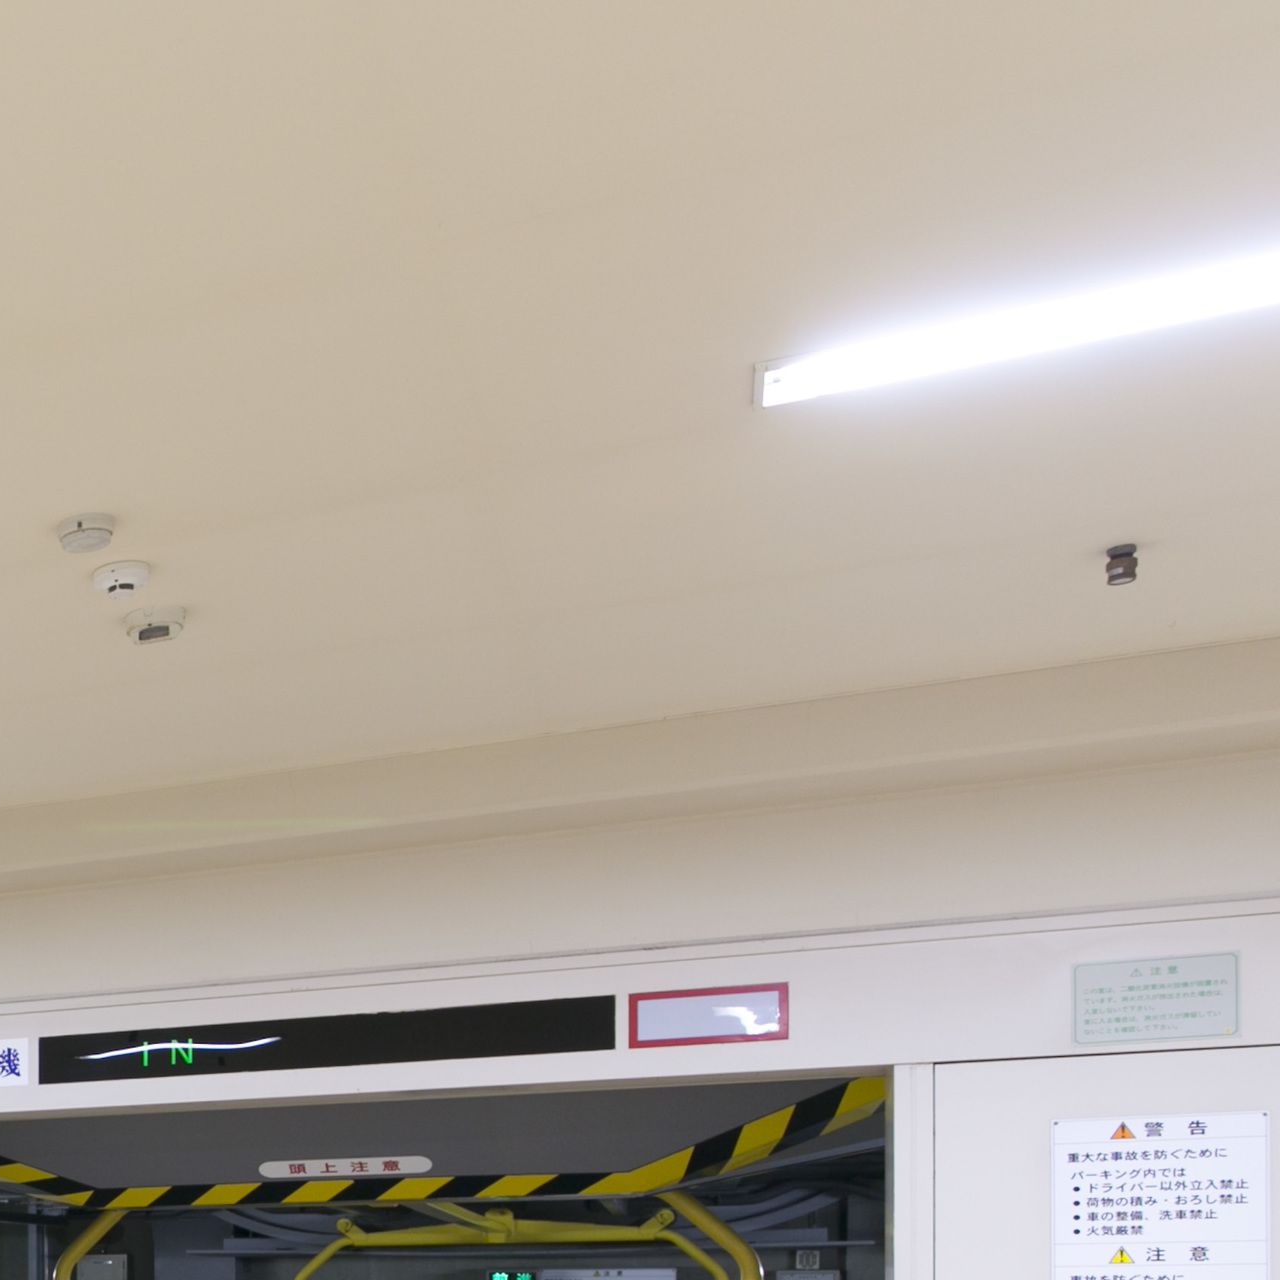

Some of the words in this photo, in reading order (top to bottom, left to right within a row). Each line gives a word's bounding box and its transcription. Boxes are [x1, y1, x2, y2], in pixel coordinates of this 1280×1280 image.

[1144, 1121, 1207, 1137] 警告
[1067, 1148, 1228, 1163] 重大な事故を防ぐために
[288, 1160, 401, 1175] 頭上注意
[1071, 1168, 1186, 1180] パーキング内では
[1089, 1179, 1249, 1193] ドライバー以外立入禁止
[1086, 1194, 1249, 1208] 荷物の積み・おろし禁止
[1086, 1225, 1144, 1236] 火気厳禁
[1146, 1246, 1209, 1262] 注意
